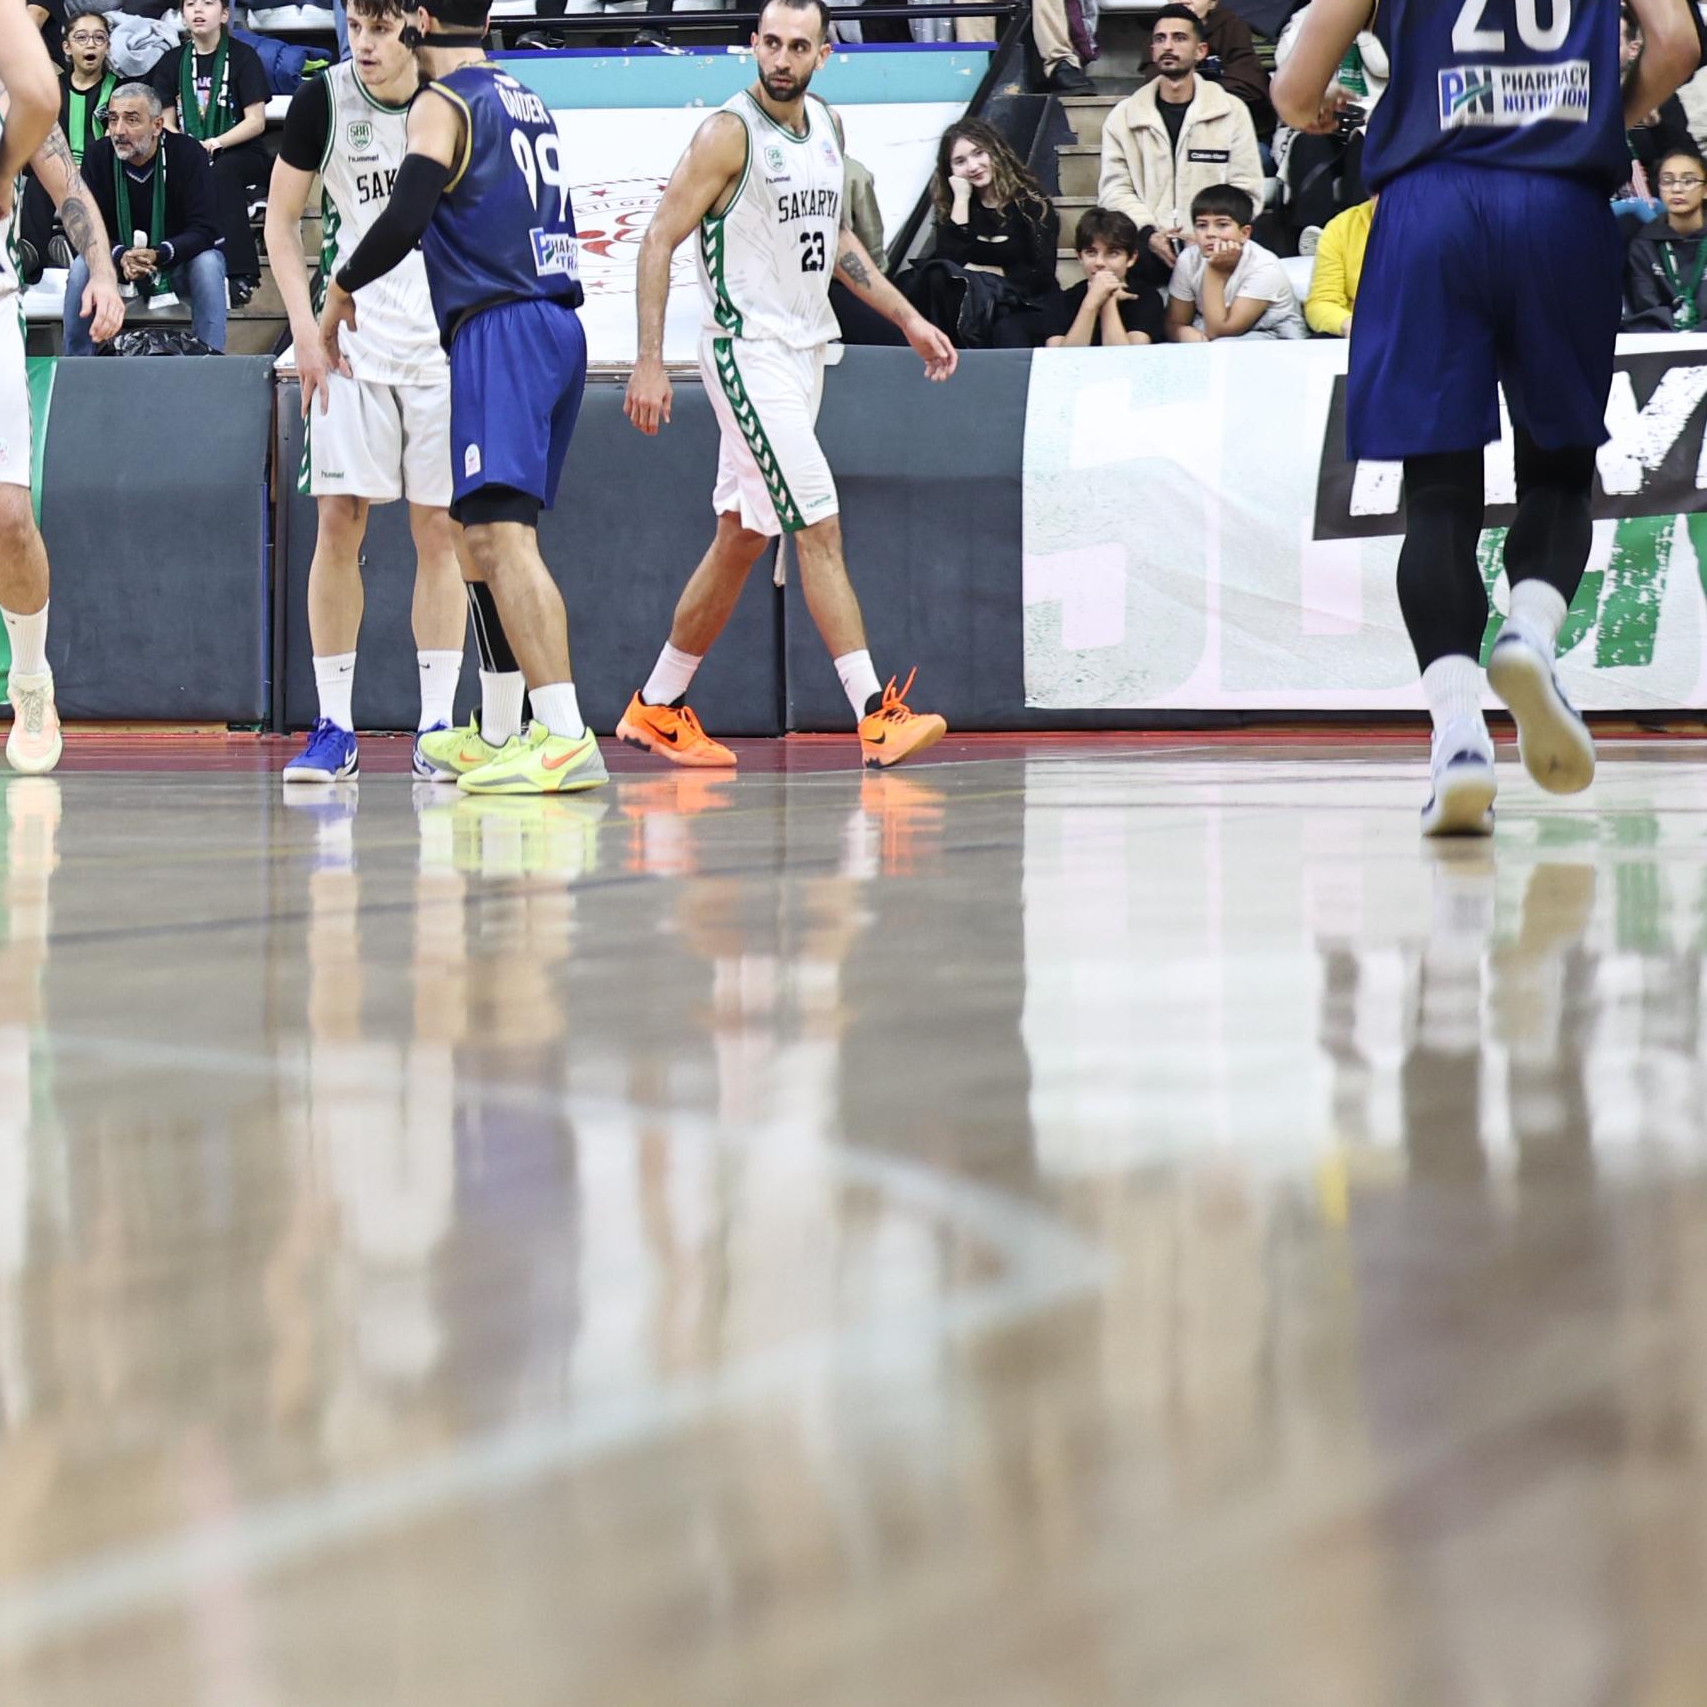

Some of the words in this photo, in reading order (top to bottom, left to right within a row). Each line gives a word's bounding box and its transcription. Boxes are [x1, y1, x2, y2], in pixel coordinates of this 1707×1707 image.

[1501, 66, 1588, 92] PHARMACY
[493, 81, 551, 125] ÖNDER
[347, 153, 380, 164] hummel
[799, 231, 825, 273] 23
